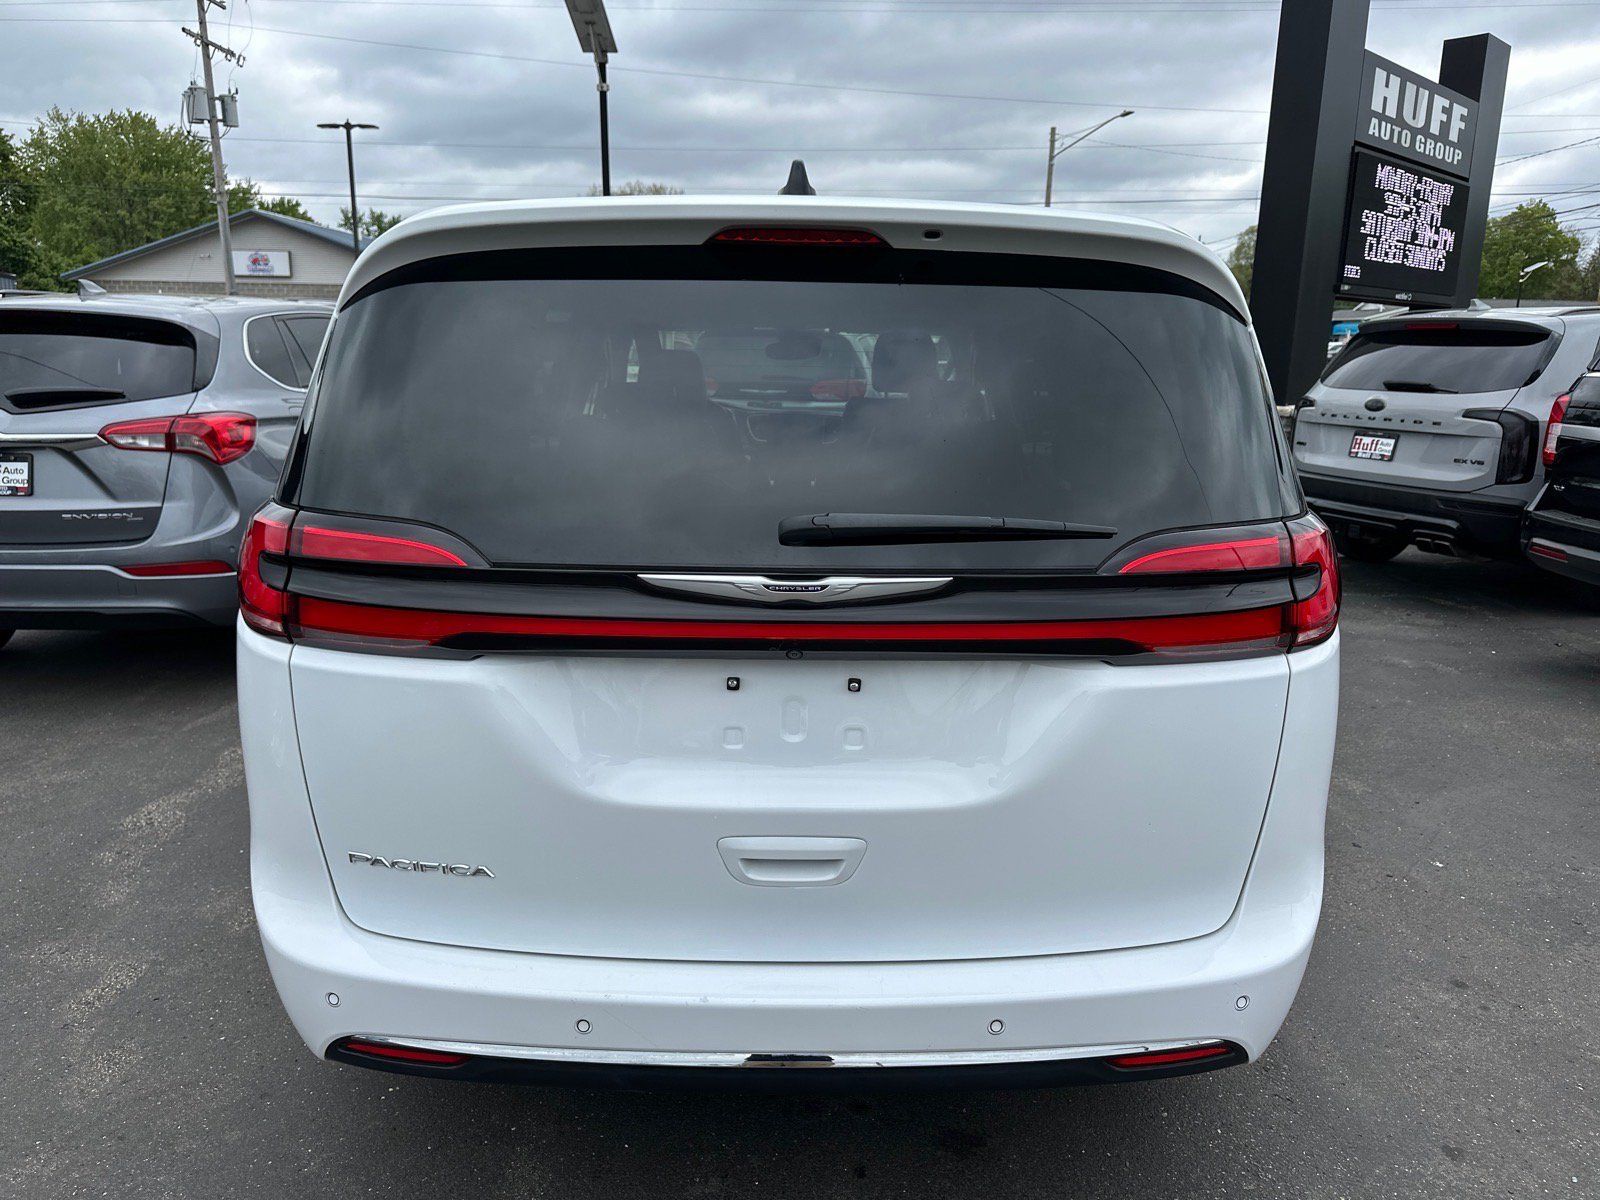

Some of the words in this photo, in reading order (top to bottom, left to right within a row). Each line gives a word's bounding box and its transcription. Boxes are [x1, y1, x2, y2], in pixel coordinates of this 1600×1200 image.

[1371, 67, 1468, 143] HUFF
[1368, 117, 1411, 148] AUTO
[1415, 134, 1462, 165] GROUP
[1352, 437, 1379, 452] Huff
[3, 466, 24, 475] Auto
[2, 476, 28, 486] Group
[62, 511, 134, 520] ENVISION
[348, 850, 496, 878] PACIFICA
